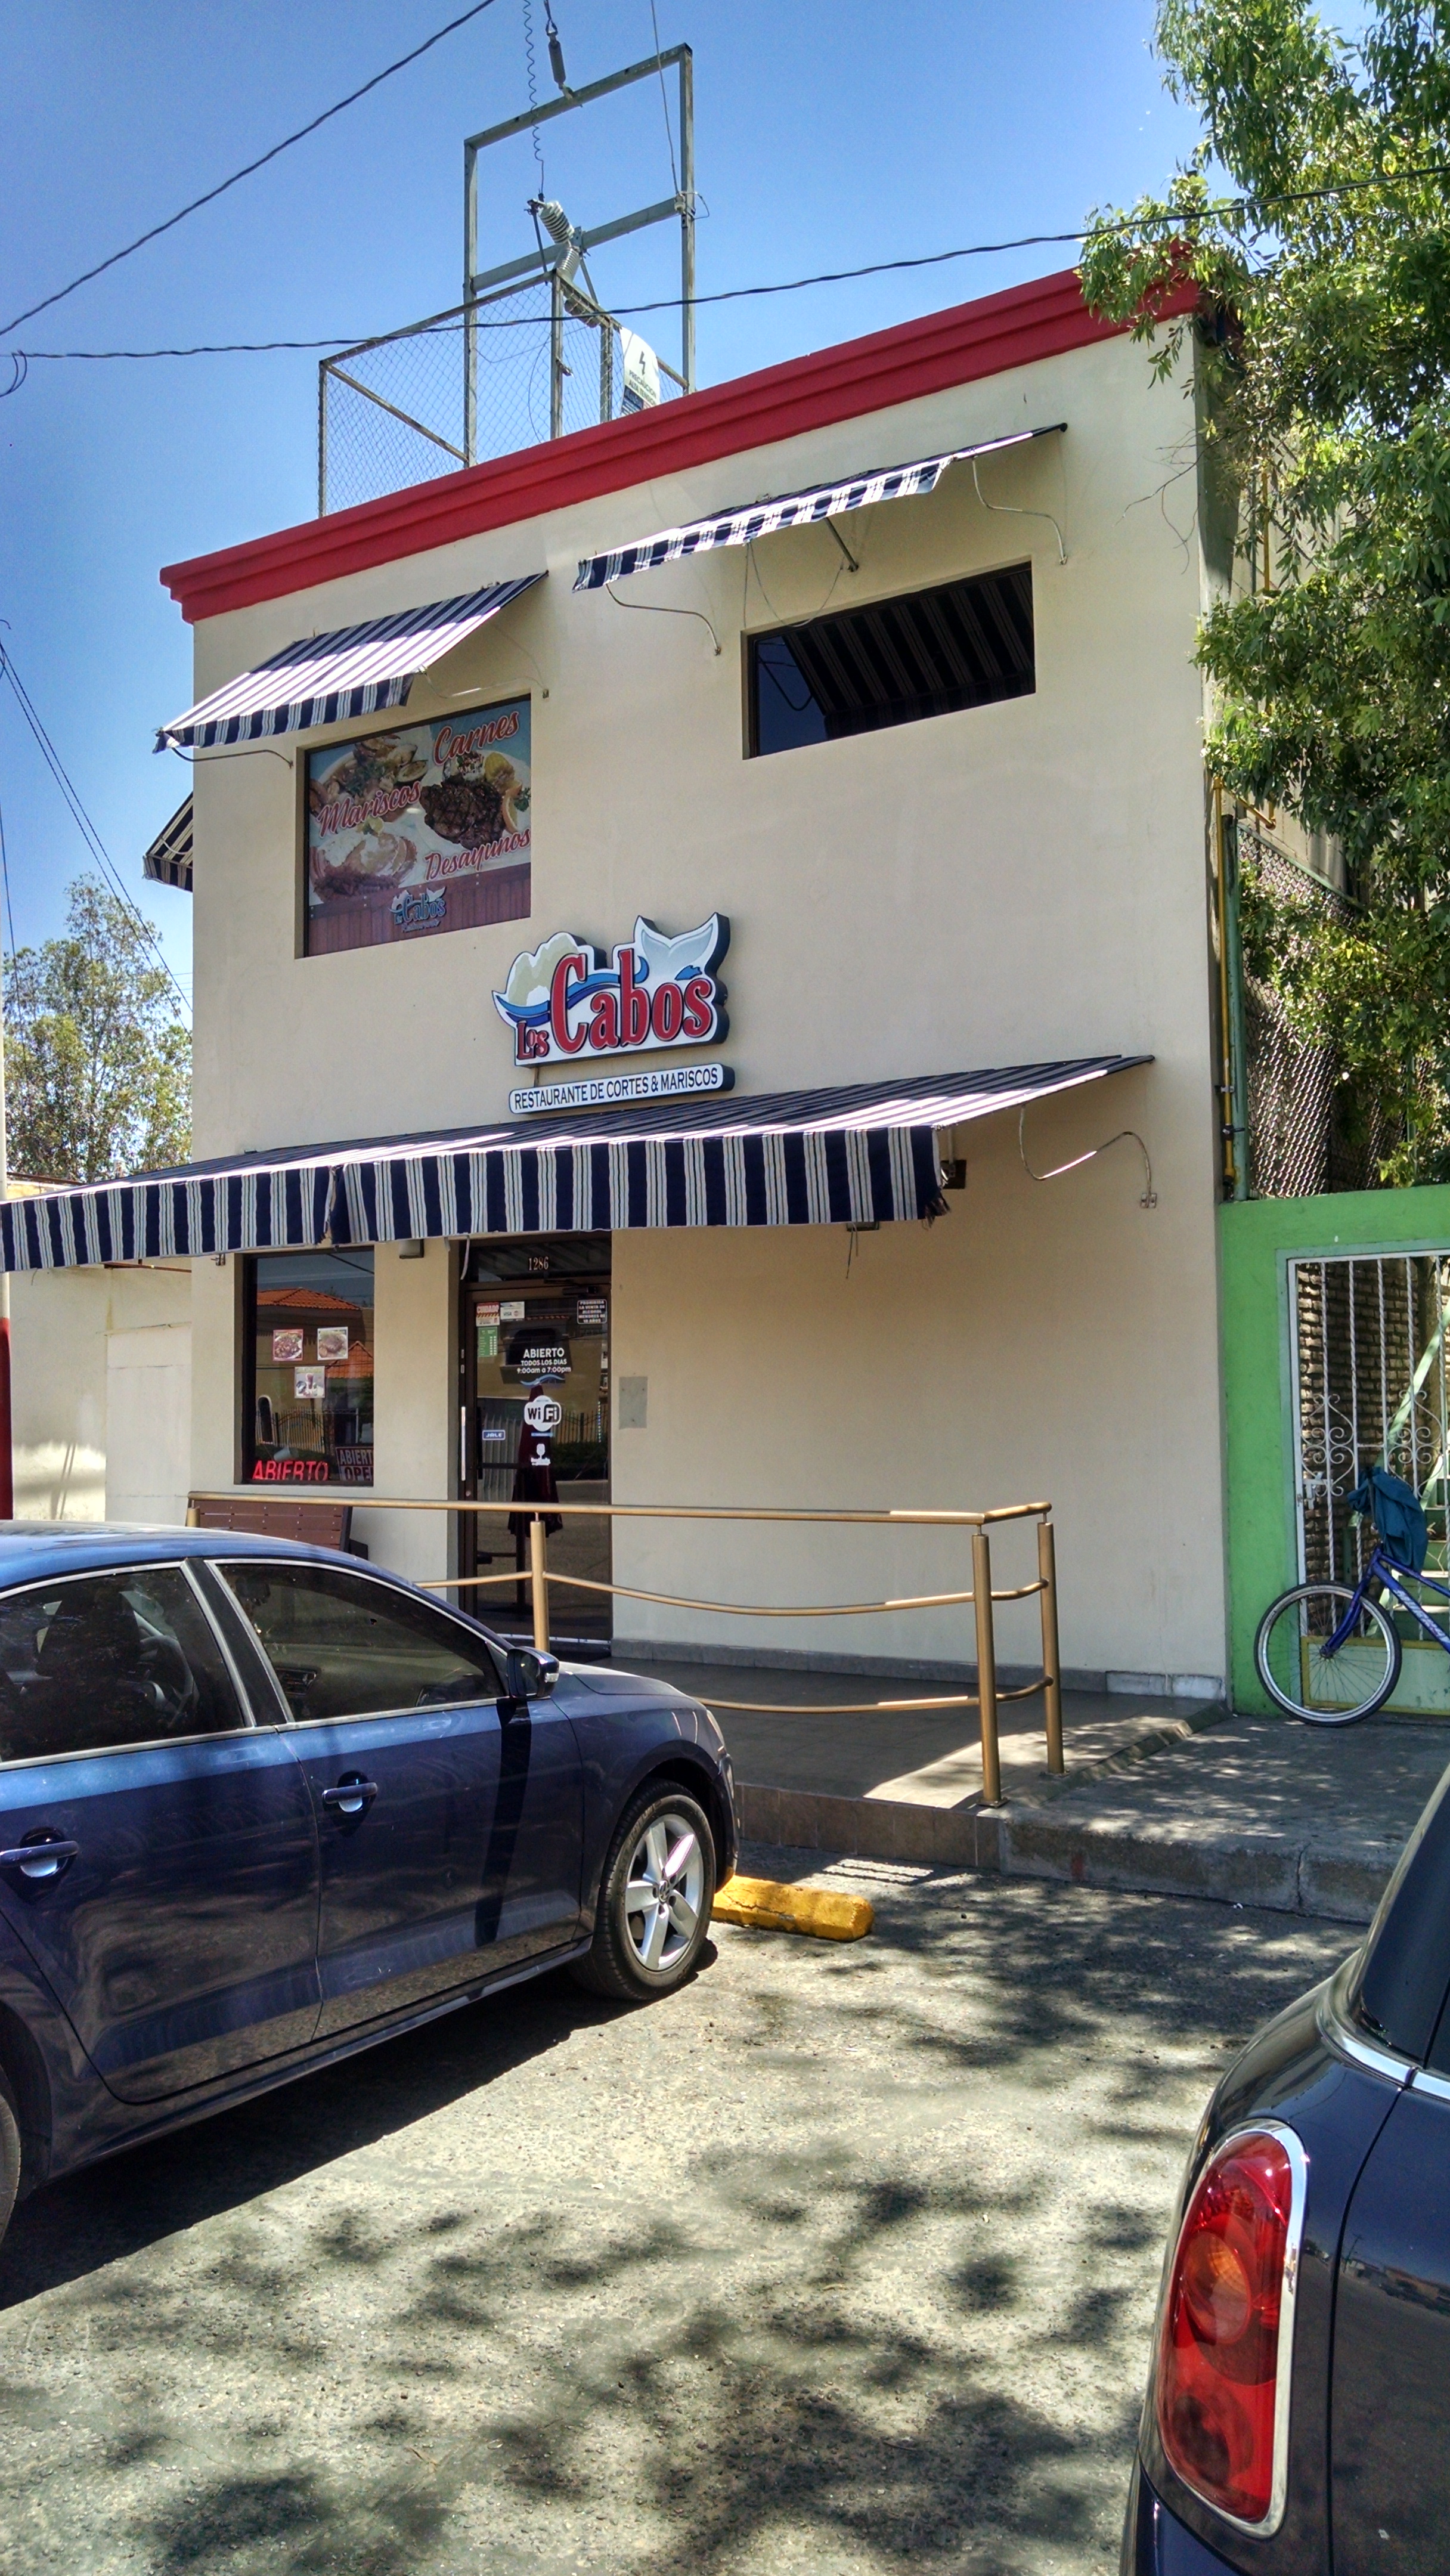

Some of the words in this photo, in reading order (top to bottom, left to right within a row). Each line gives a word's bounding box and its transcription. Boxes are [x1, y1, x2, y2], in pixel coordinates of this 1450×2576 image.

[628, 379, 639, 393] ALTA
[433, 711, 519, 766] Carnes
[316, 781, 421, 839] Mariscos
[424, 828, 531, 881] Desayunos
[402, 893, 446, 923] Cabos
[516, 1020, 549, 1060] Los
[550, 948, 714, 1054] Cabos
[515, 1084, 588, 1110] RESTAURANTE
[590, 1082, 605, 1100] DE
[606, 1076, 649, 1098] CORTES
[651, 1075, 659, 1093] &
[661, 1067, 718, 1091] MARISCOS
[528, 1256, 549, 1271] 1286
[522, 1347, 565, 1359] ABIERTO
[252, 1460, 329, 1481] ABIERTO
